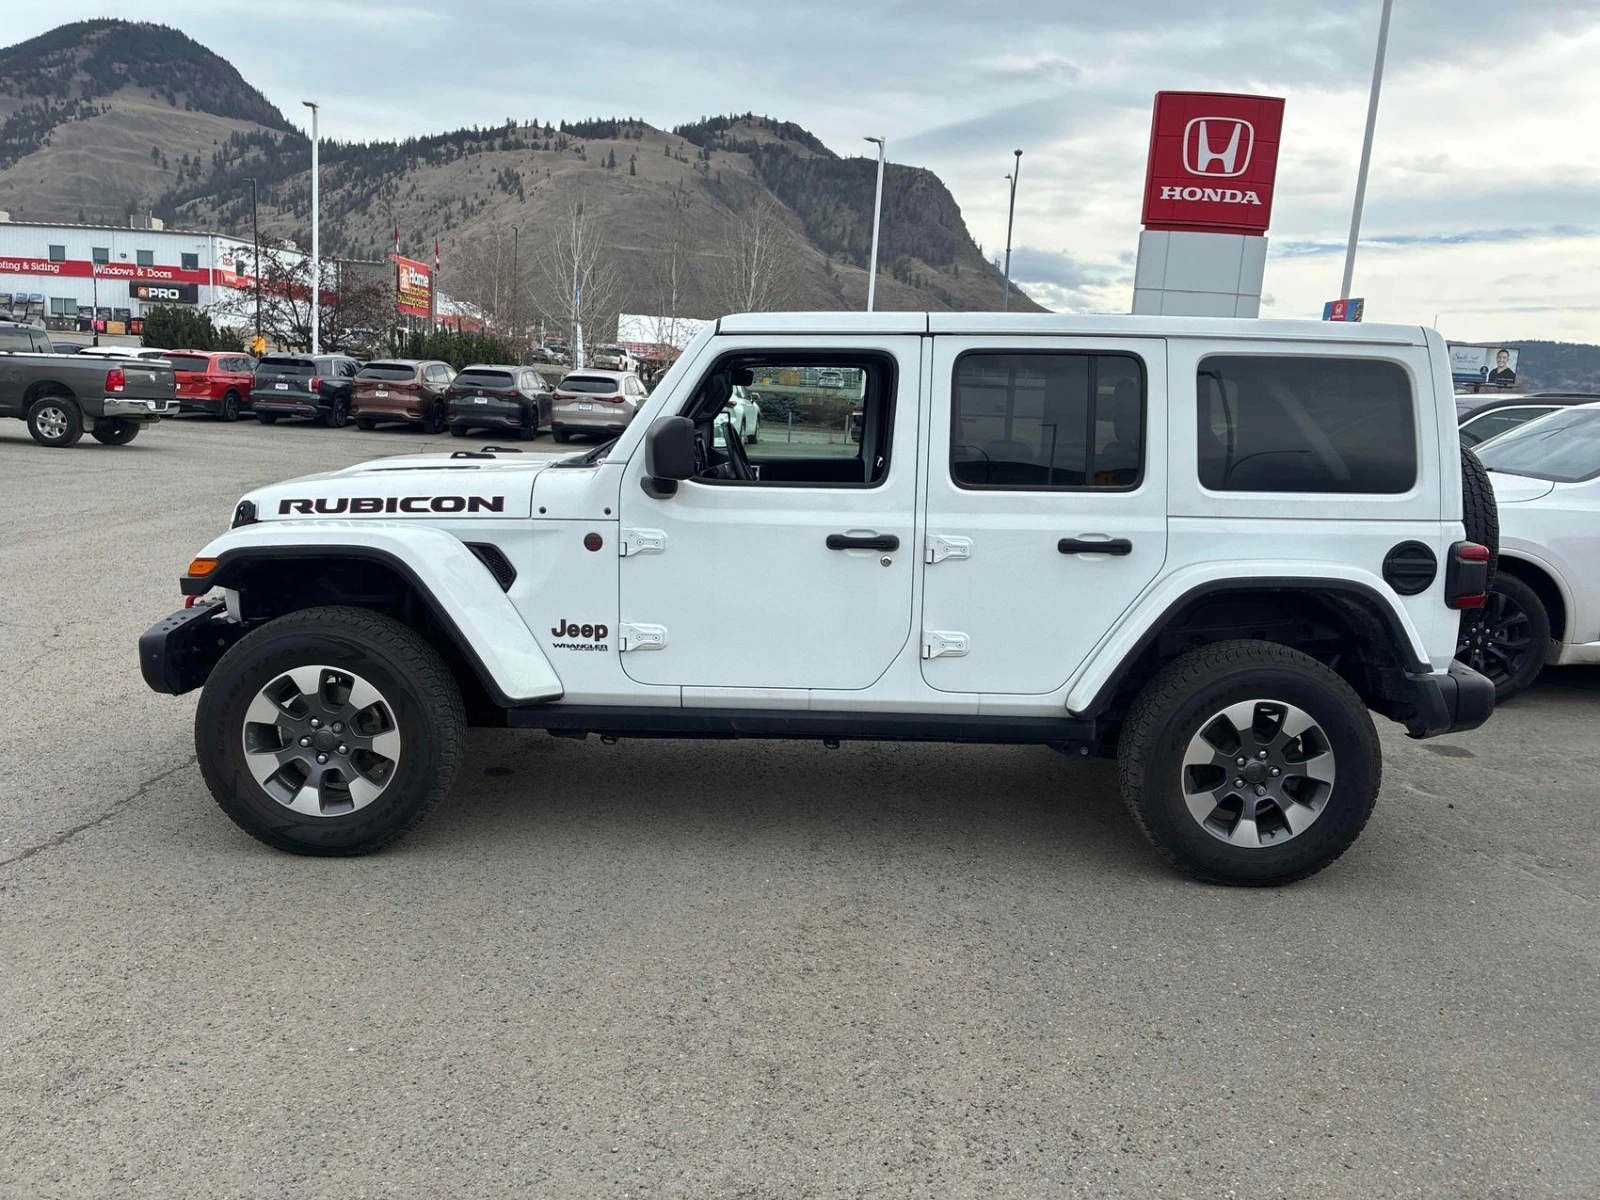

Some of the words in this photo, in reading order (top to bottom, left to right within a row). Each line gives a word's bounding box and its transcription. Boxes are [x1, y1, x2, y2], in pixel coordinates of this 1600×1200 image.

[1160, 186, 1262, 205] HONDA
[22, 261, 30, 270] &
[31, 262, 60, 274] Siding
[95, 265, 134, 276] Windows
[136, 268, 144, 276] &
[147, 268, 173, 278] Doors
[409, 267, 429, 288] Home
[148, 287, 180, 300] PRO
[278, 496, 505, 515] RUBICON
[551, 618, 609, 642] Jeep
